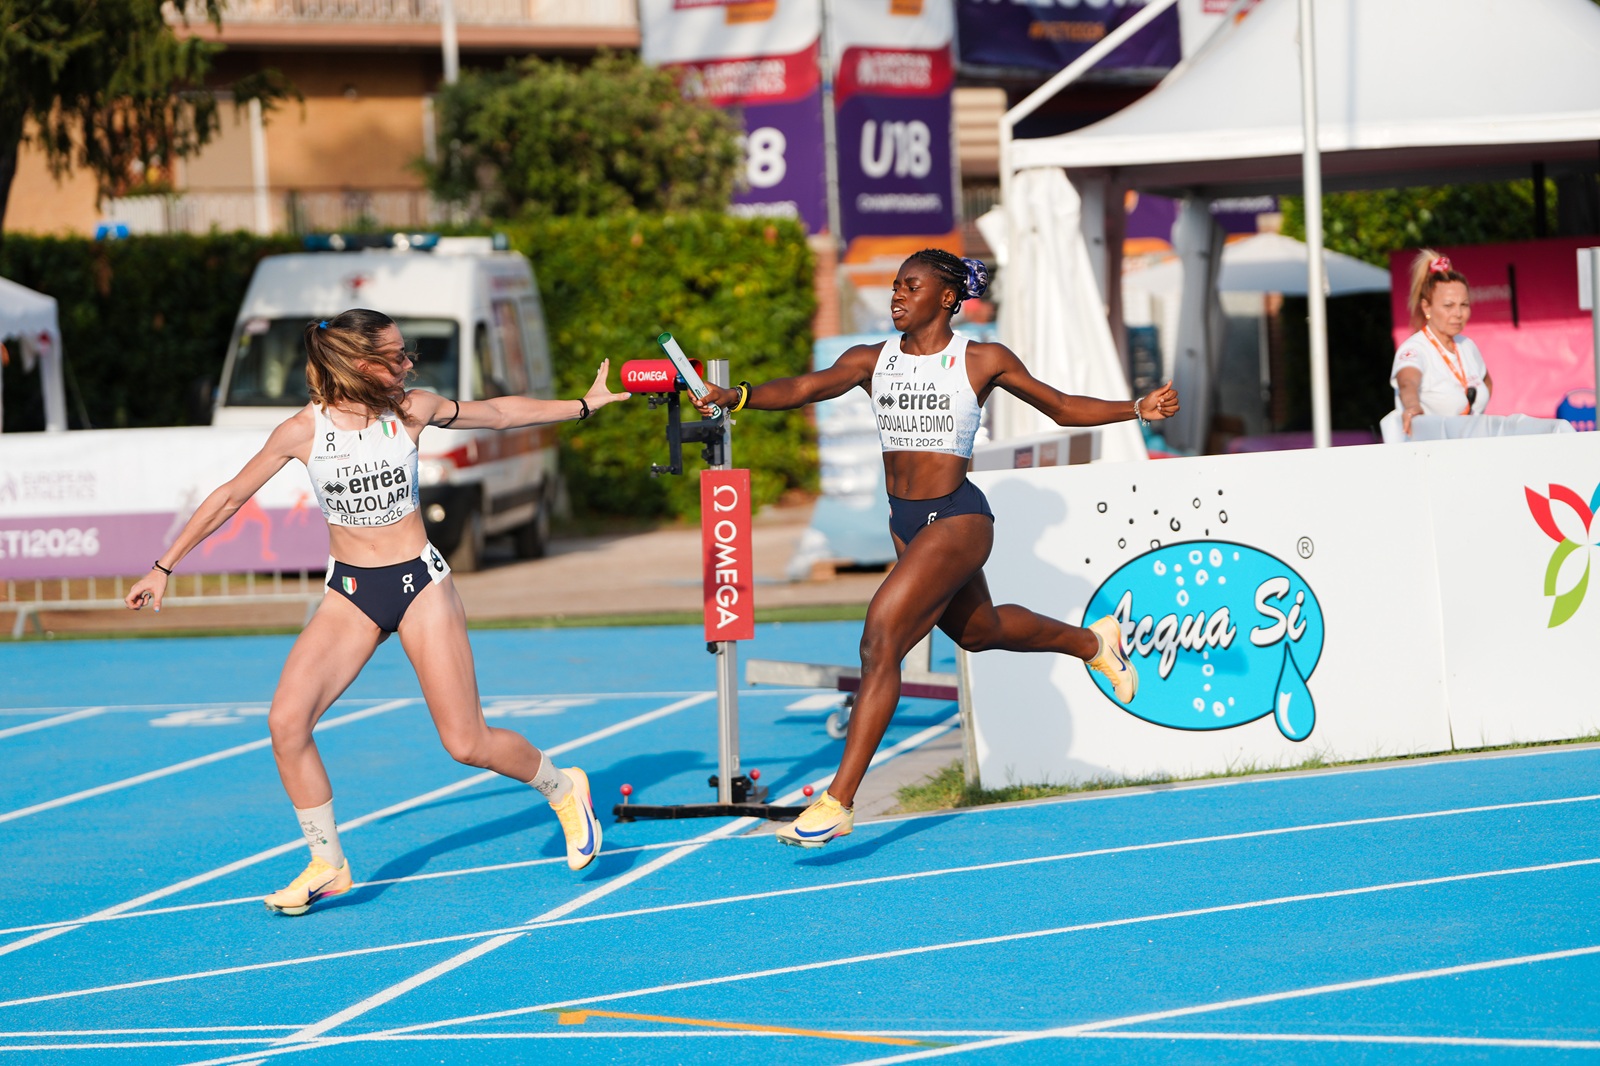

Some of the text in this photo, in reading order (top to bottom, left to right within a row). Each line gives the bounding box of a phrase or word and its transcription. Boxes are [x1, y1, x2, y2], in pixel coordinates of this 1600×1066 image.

[860, 119, 931, 178] U18
[637, 370, 668, 381] OMEGA
[890, 382, 936, 391] ITALIA
[878, 414, 954, 432] DOUALLA EDIMO
[890, 437, 943, 447] RIETI 2026
[336, 460, 390, 478] ITALIA
[325, 485, 410, 514] CALZOLARI
[340, 507, 403, 525] RIETI 2026
[714, 520, 739, 629] OMEGA
[1110, 575, 1307, 680] Acqua Si
